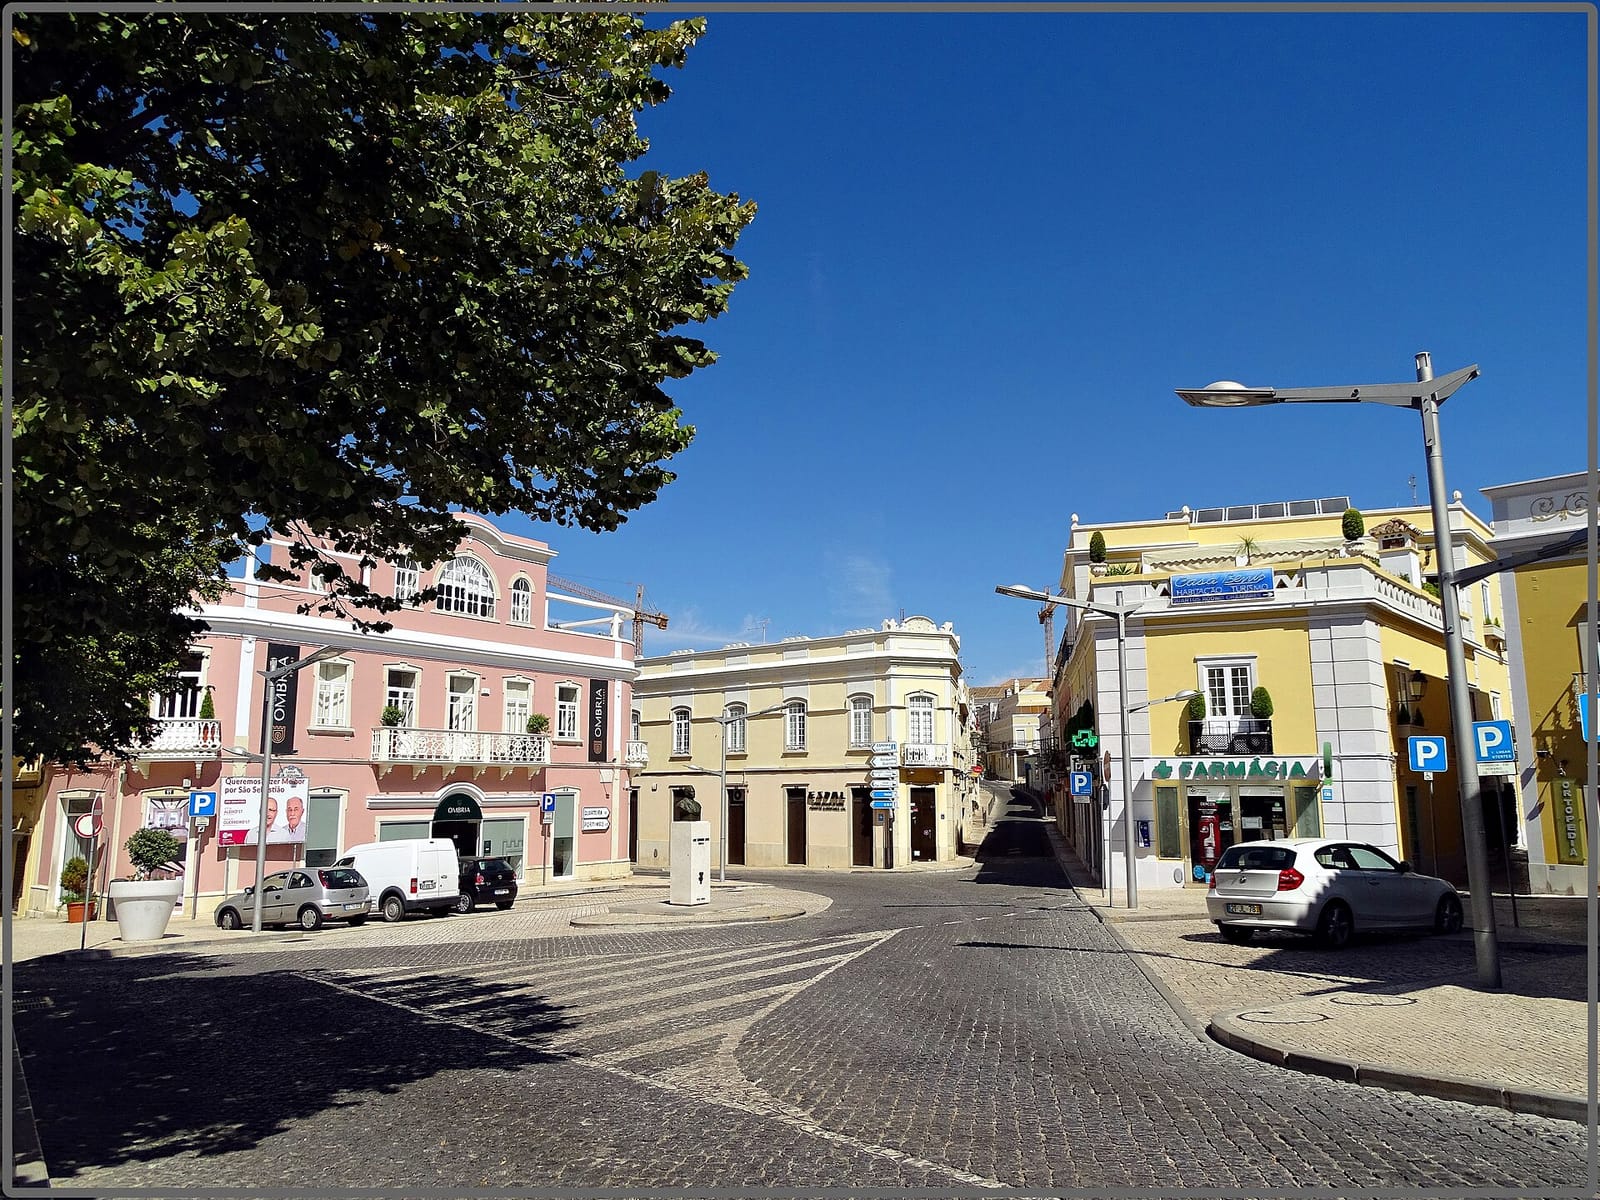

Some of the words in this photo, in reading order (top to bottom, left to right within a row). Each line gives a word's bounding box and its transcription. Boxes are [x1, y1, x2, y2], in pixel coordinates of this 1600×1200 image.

[1231, 583, 1269, 593] TURISMO
[273, 656, 290, 722] OMBRA
[594, 688, 603, 738] OMBRIA
[1477, 726, 1503, 758] P
[1416, 741, 1439, 768] P
[1180, 755, 1307, 779] FARMÁCIA
[224, 787, 237, 795] por
[238, 785, 250, 794] São
[252, 785, 285, 794] Sestião
[225, 777, 261, 786] Queremos
[1074, 774, 1088, 793] P
[194, 794, 211, 814] P
[447, 806, 471, 814] OMBRIA
[544, 795, 553, 810] P
[1562, 781, 1578, 857] ORTOPEDIA
